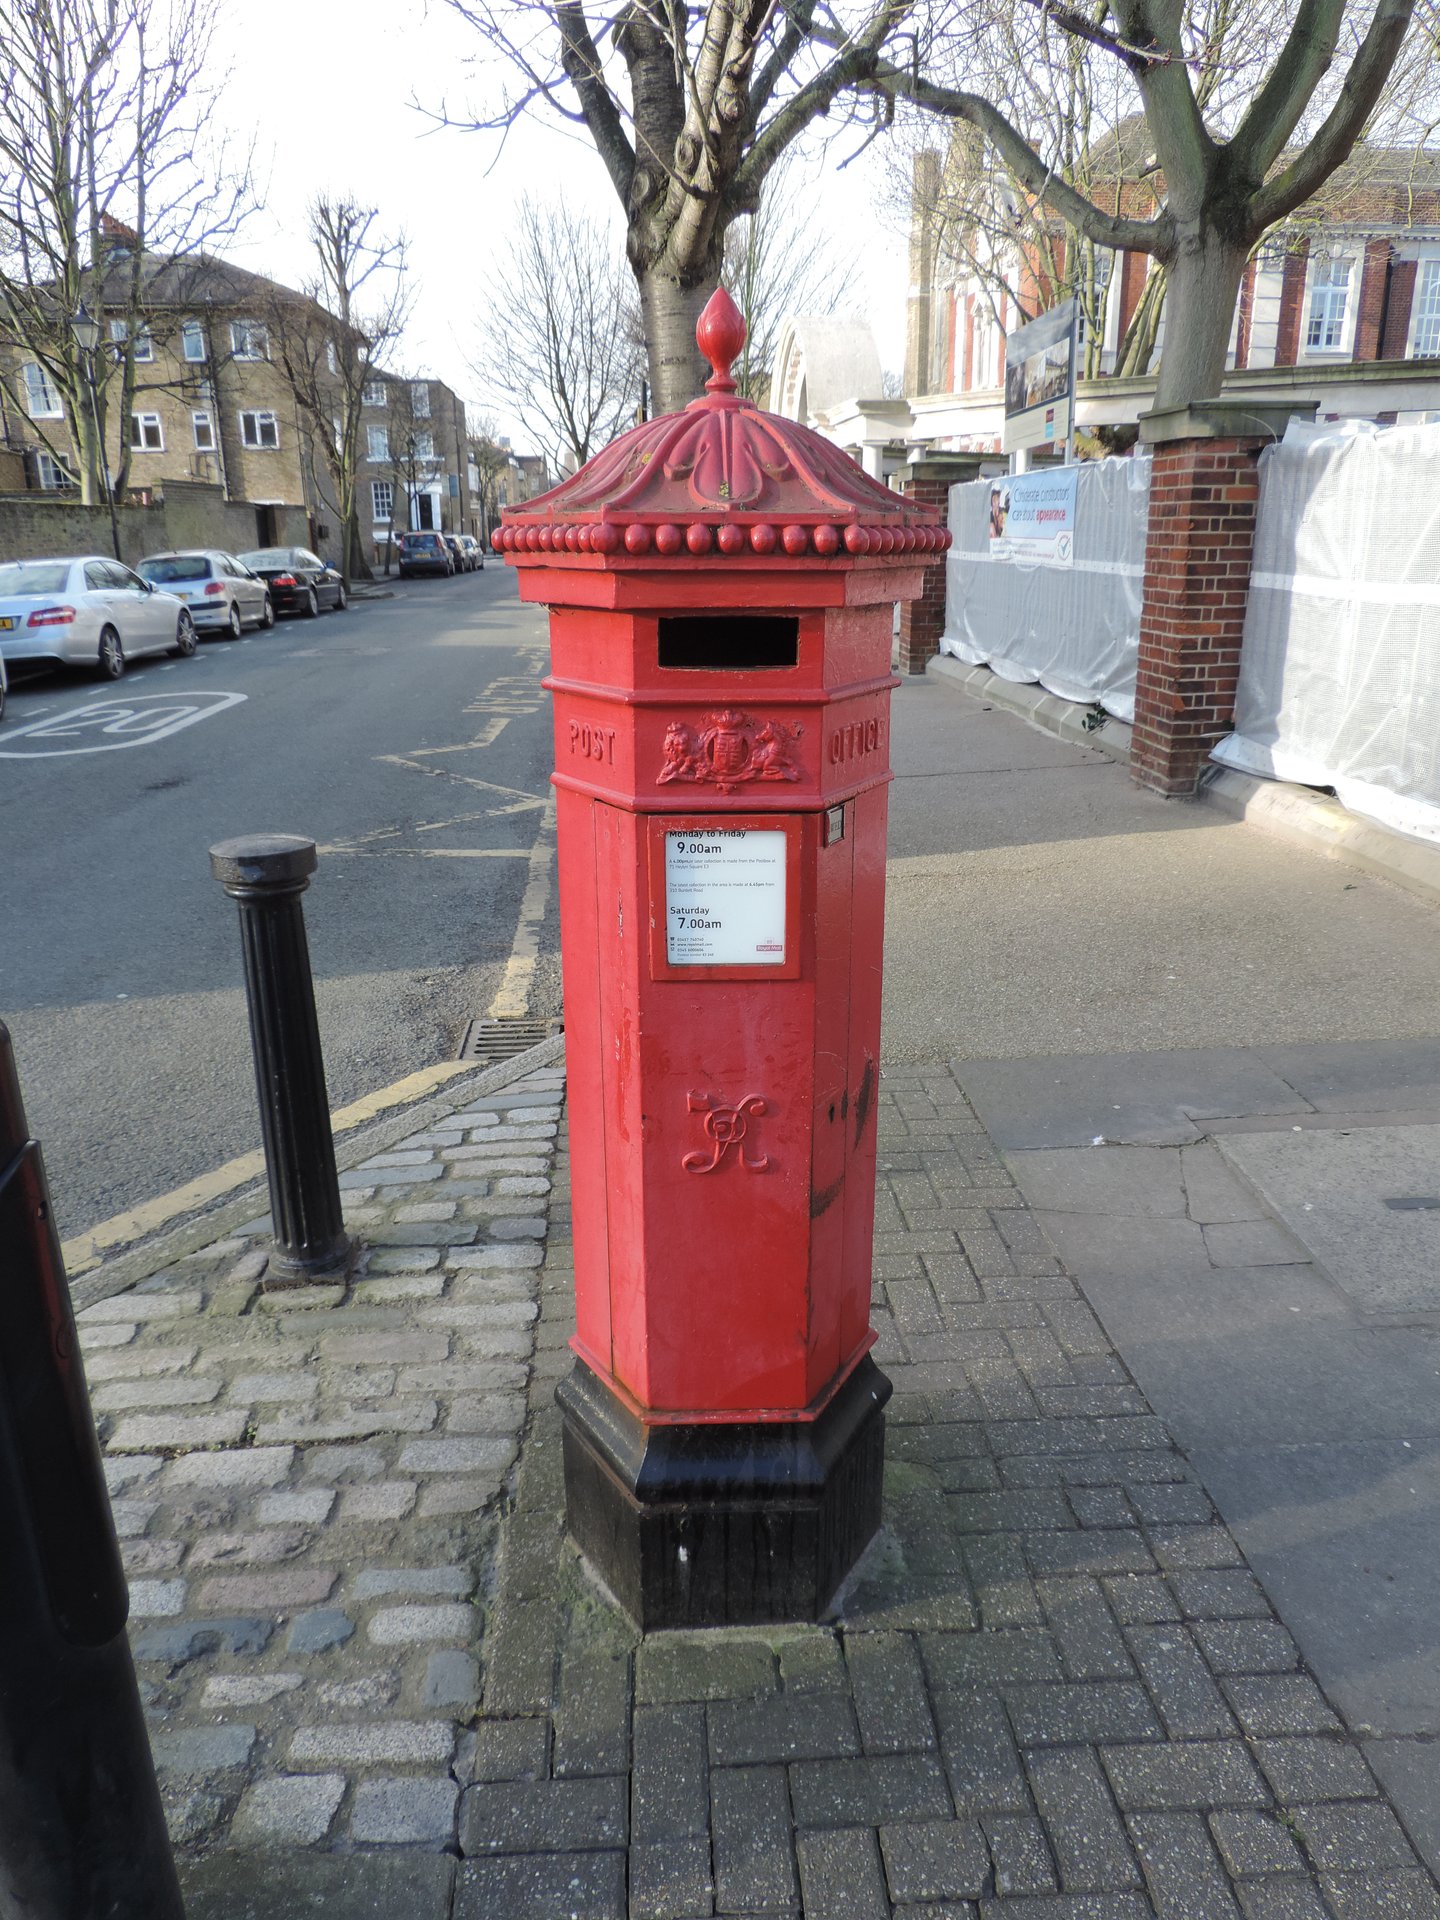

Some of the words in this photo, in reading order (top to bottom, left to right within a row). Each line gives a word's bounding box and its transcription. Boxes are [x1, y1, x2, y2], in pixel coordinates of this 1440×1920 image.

[25, 706, 199, 737] 20
[568, 719, 616, 765] POST
[831, 717, 886, 765] OFFICE
[669, 831, 704, 839] Monday
[719, 831, 747, 839] Friday
[677, 841, 722, 854] 9.00am
[670, 906, 710, 916] Saturday
[678, 917, 722, 929] 7.00am
